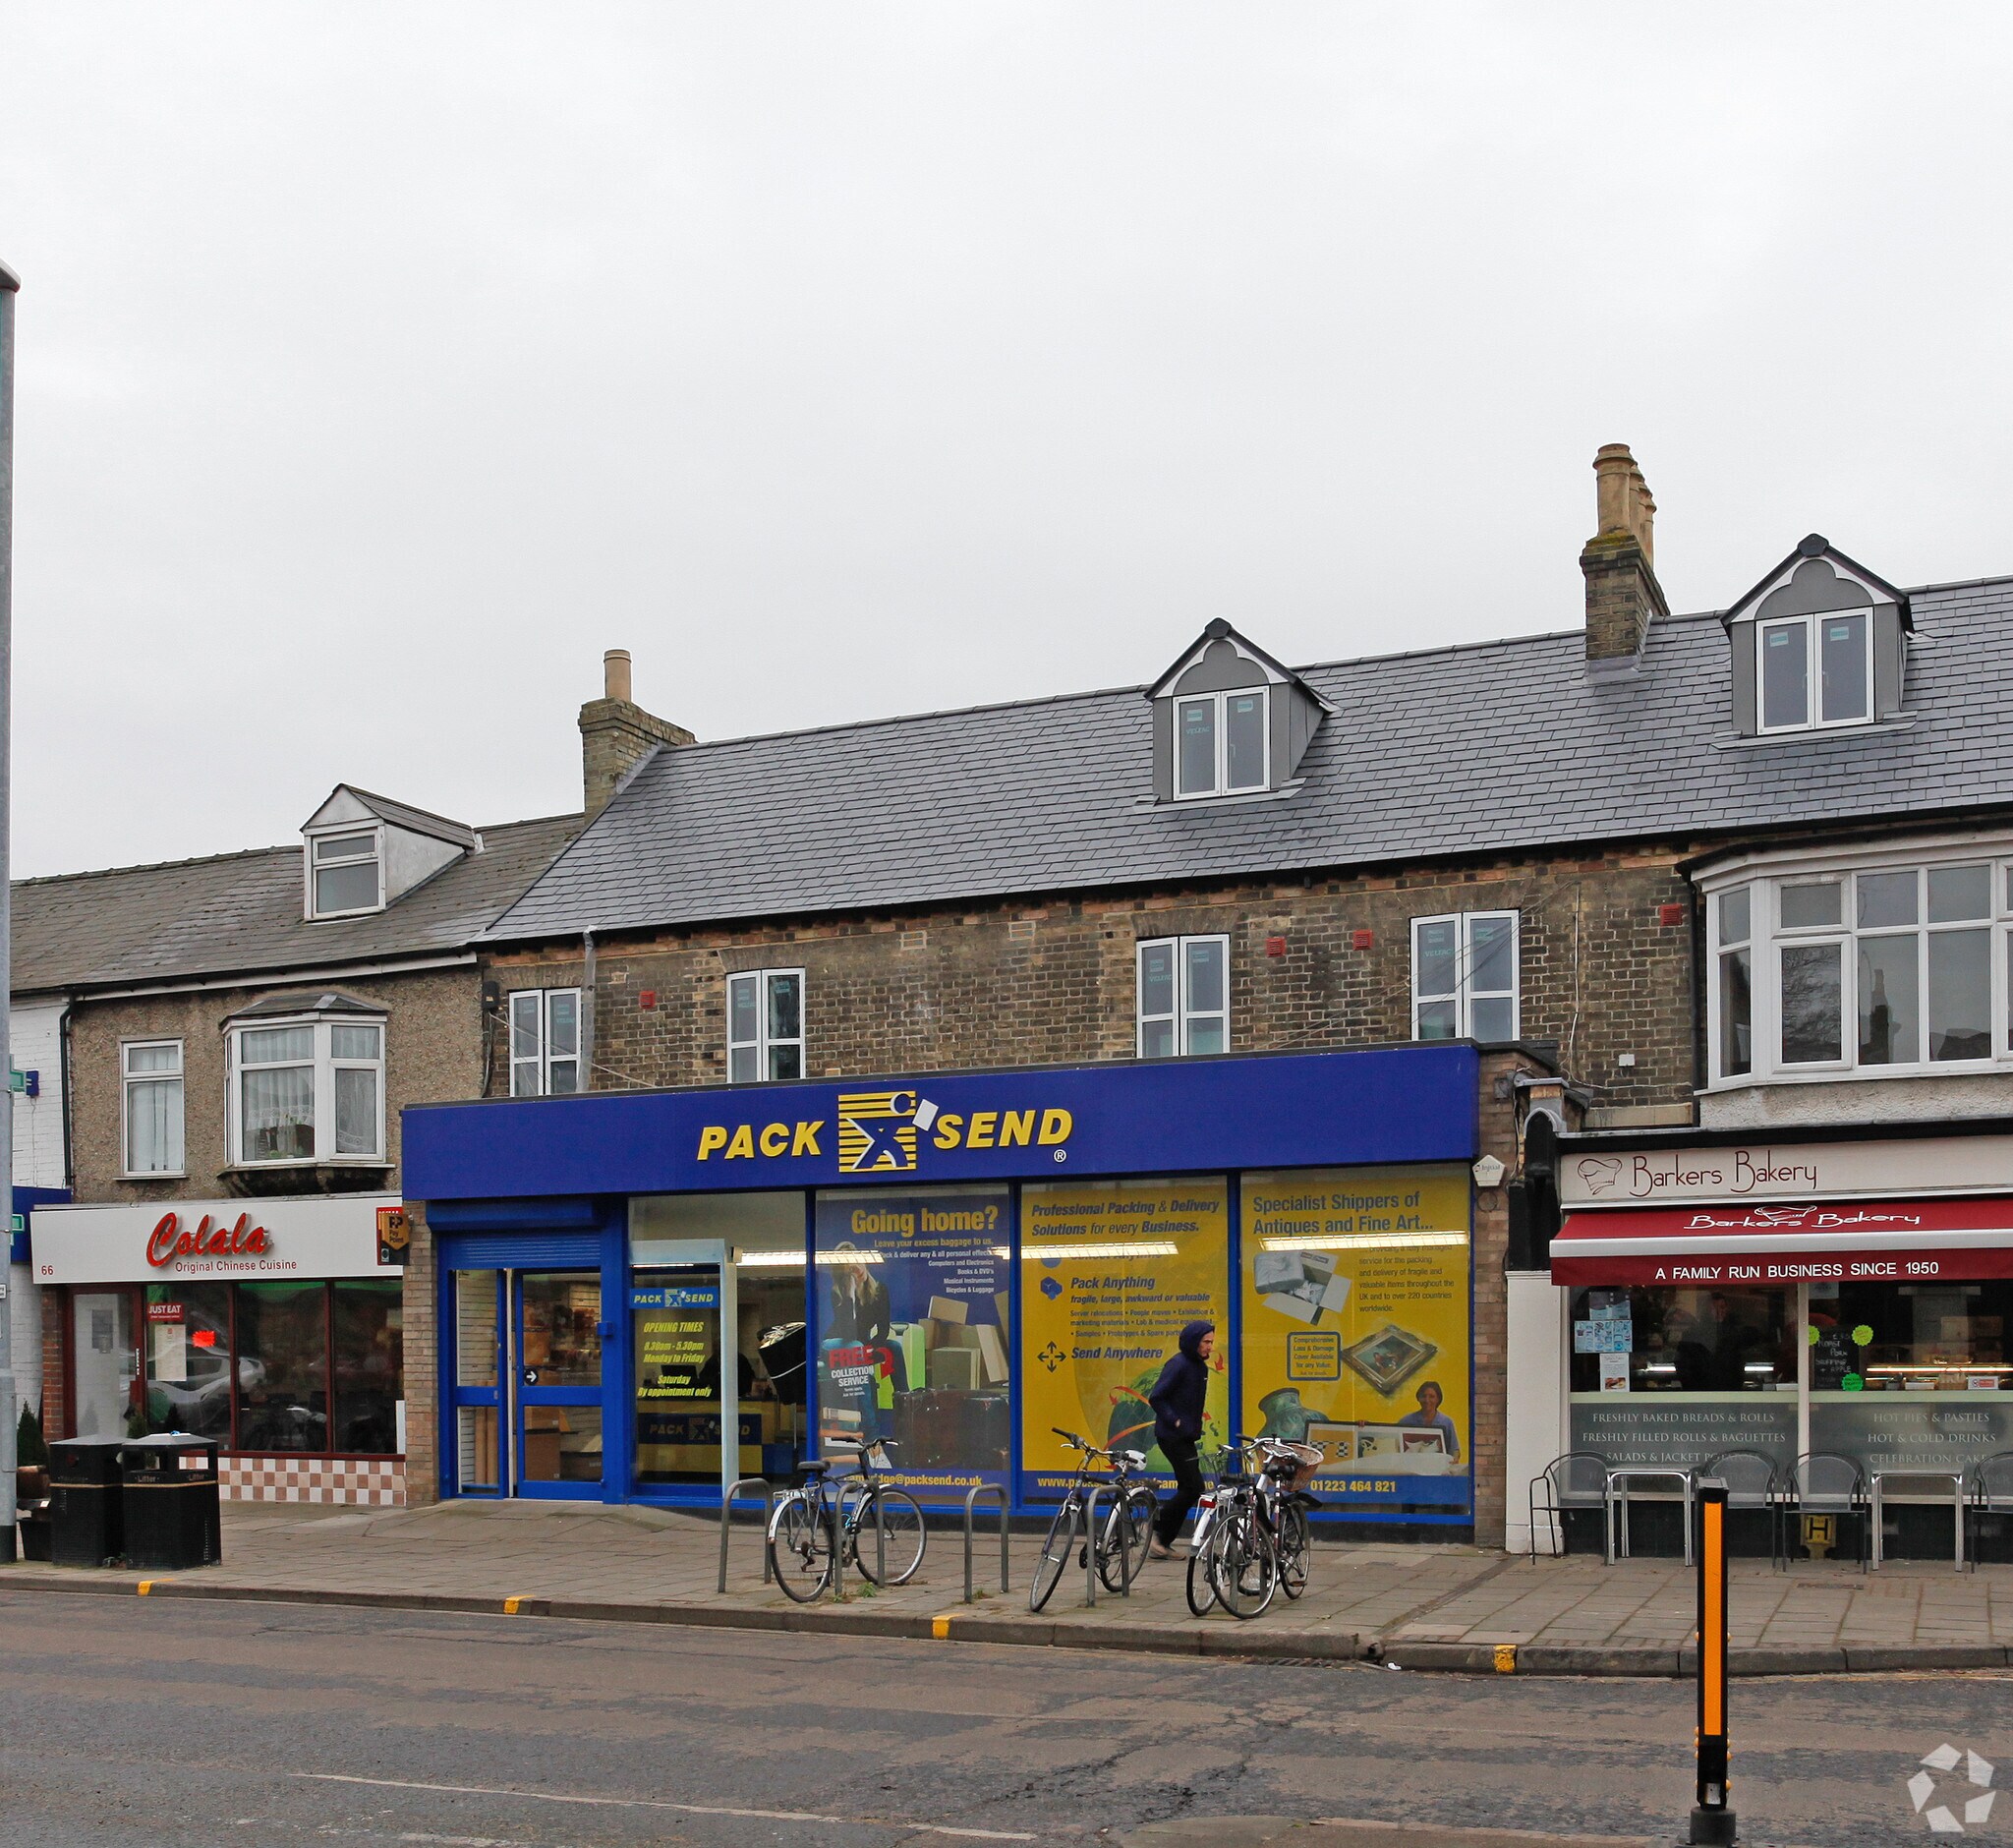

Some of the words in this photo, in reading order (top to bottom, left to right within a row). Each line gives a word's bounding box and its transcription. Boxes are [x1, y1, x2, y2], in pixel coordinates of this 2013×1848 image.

[697, 1121, 825, 1161] PACK
[933, 1108, 1072, 1150] SEND
[1630, 1155, 1722, 1197] Barkers
[1730, 1150, 1817, 1192] Bakery
[1032, 1203, 1105, 1217] Professional
[1108, 1201, 1156, 1215] Packing
[1158, 1201, 1167, 1212] &
[1171, 1199, 1219, 1214] Delivery
[1253, 1195, 1327, 1215] Specialist
[1331, 1193, 1400, 1212] Shippers
[1404, 1191, 1421, 1207] of
[851, 1209, 915, 1238] Going
[921, 1205, 999, 1232] home?
[1253, 1218, 1320, 1237] Antiques
[1324, 1216, 1353, 1232] and
[1358, 1216, 1391, 1232] Fine
[1683, 1215, 1803, 1230] Barkers
[1811, 1211, 1921, 1228] Bakery
[1032, 1224, 1086, 1237] Solutions
[1090, 1222, 1106, 1235] for
[1108, 1224, 1138, 1237] every
[1141, 1220, 1200, 1233] Business.
[146, 1212, 267, 1267] Colala
[940, 1238, 972, 1247] baggage
[175, 1260, 213, 1274] Original
[216, 1260, 257, 1271] Chinese
[259, 1259, 297, 1270] Cuisine
[1407, 1256, 1432, 1265] packing
[41, 1265, 54, 1276] 66
[1655, 1268, 1667, 1280] A
[1672, 1267, 1721, 1280] FAMILY
[1729, 1266, 1760, 1279] RUN
[1767, 1263, 1843, 1278] BUSINESS
[1850, 1262, 1897, 1276] SINCE
[1905, 1261, 1939, 1275] 1950
[1070, 1277, 1100, 1290] Pack
[1102, 1276, 1156, 1291] Anything
[1407, 1280, 1442, 1289] throughout
[634, 1295, 661, 1303] PACK
[684, 1294, 714, 1302] SEND
[1070, 1295, 1099, 1304] fragile,
[1100, 1295, 1123, 1304] large,
[1124, 1294, 1163, 1303] awkward
[1175, 1293, 1211, 1302] valuable
[148, 1305, 166, 1314] JUST
[167, 1304, 181, 1313] EAT
[643, 1322, 679, 1333] OPENING
[678, 1321, 705, 1333] TIMES
[643, 1354, 672, 1363] Monday
[672, 1354, 681, 1362] to
[681, 1353, 706, 1363] Friday
[829, 1344, 875, 1369] FREE
[1071, 1347, 1102, 1359] Send
[1103, 1347, 1163, 1360] Anywhere
[831, 1364, 875, 1378] COLLECTION
[658, 1374, 691, 1385] Saturday
[838, 1376, 869, 1387] SERVICE
[637, 1387, 647, 1397] By
[647, 1387, 695, 1397] appointment
[694, 1385, 713, 1397] only
[1592, 1413, 1639, 1423] FRESHLY
[1642, 1413, 1679, 1422] BAKED
[1683, 1413, 1725, 1422] BREADS
[1727, 1413, 1737, 1422] &
[1740, 1413, 1775, 1422] ROLLS
[1873, 1414, 1898, 1423] HOT
[1931, 1413, 1940, 1422] &
[1944, 1413, 1990, 1422] PASTIES
[650, 1424, 684, 1435] PACK
[1582, 1433, 1630, 1442] FRESHLY
[1632, 1433, 1669, 1442] FILLED
[1673, 1433, 1707, 1442] ROLLS
[1710, 1433, 1719, 1442] &
[1721, 1432, 1786, 1442] BAGUETTES
[1868, 1433, 1893, 1443] HOT
[1897, 1434, 1907, 1443] &
[1910, 1433, 1945, 1443] COLD
[1948, 1432, 1996, 1443] DRINKS
[1606, 1452, 1646, 1462] SALADS
[1649, 1452, 1658, 1462] &
[1660, 1452, 1702, 1463] JACKET
[1869, 1453, 1951, 1464] CELEBRATION
[1310, 1479, 1346, 1492] 01223
[1350, 1480, 1372, 1492] 464
[1375, 1480, 1396, 1492] 821
[1809, 1517, 1828, 1540] H
